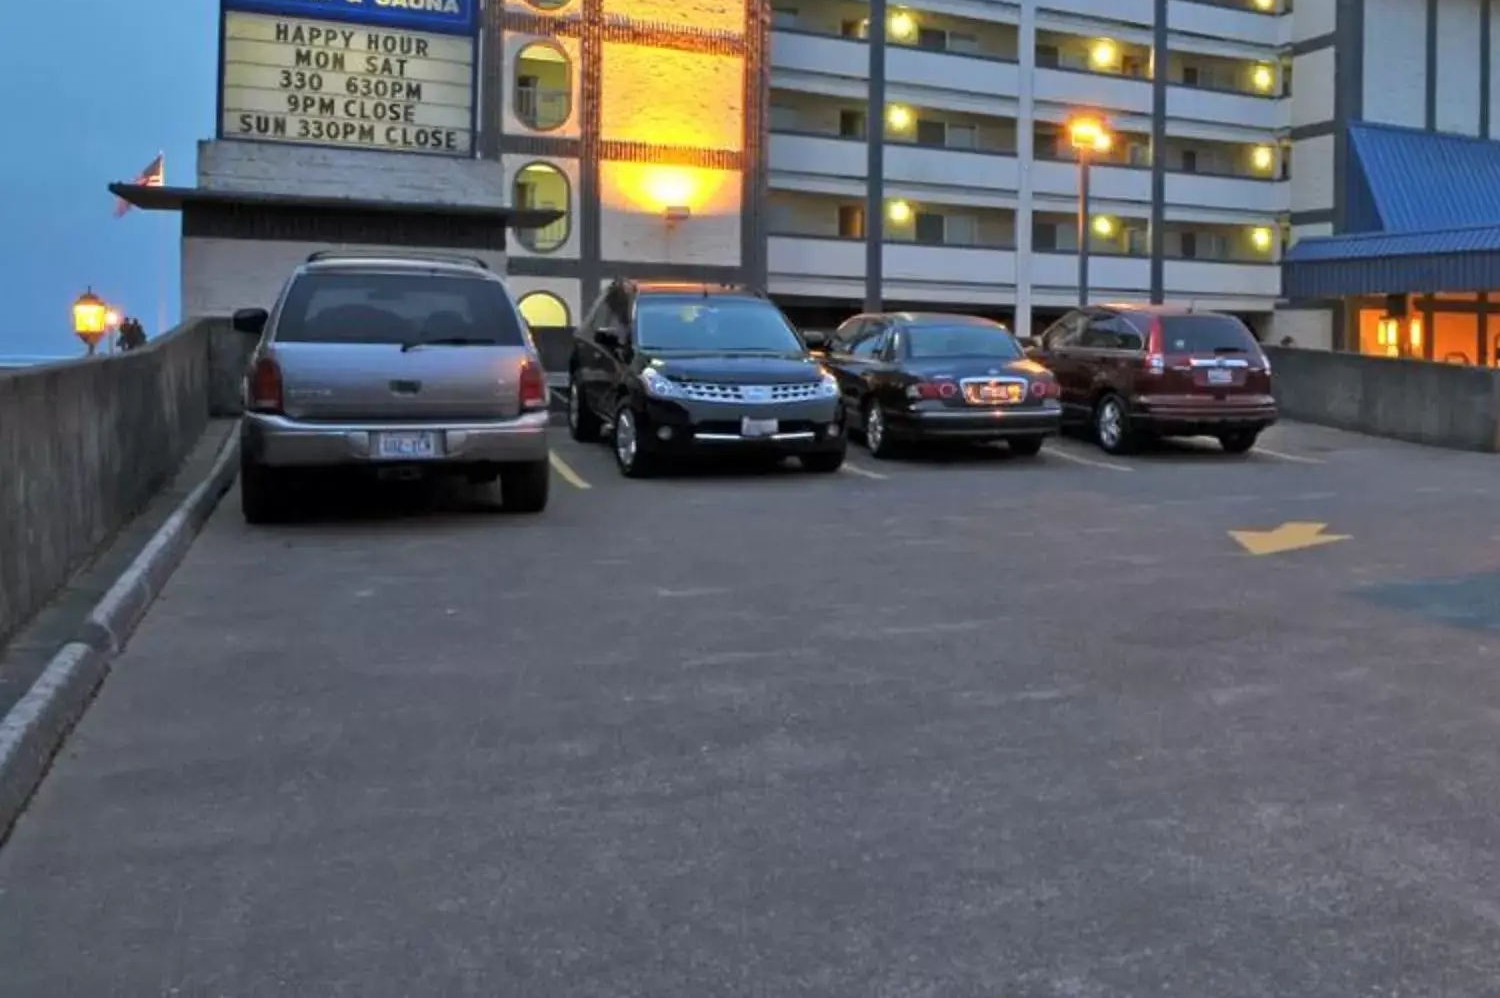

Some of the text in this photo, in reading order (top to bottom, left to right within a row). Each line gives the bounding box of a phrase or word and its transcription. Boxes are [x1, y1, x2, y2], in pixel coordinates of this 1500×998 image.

[275, 23, 429, 57] HAPPY HOUR
[295, 49, 408, 76] MON SAT
[279, 70, 422, 101] 330 630PM
[286, 94, 416, 123] 9PM CLOSE
[239, 114, 458, 149] SUN 330PM CLOSE
